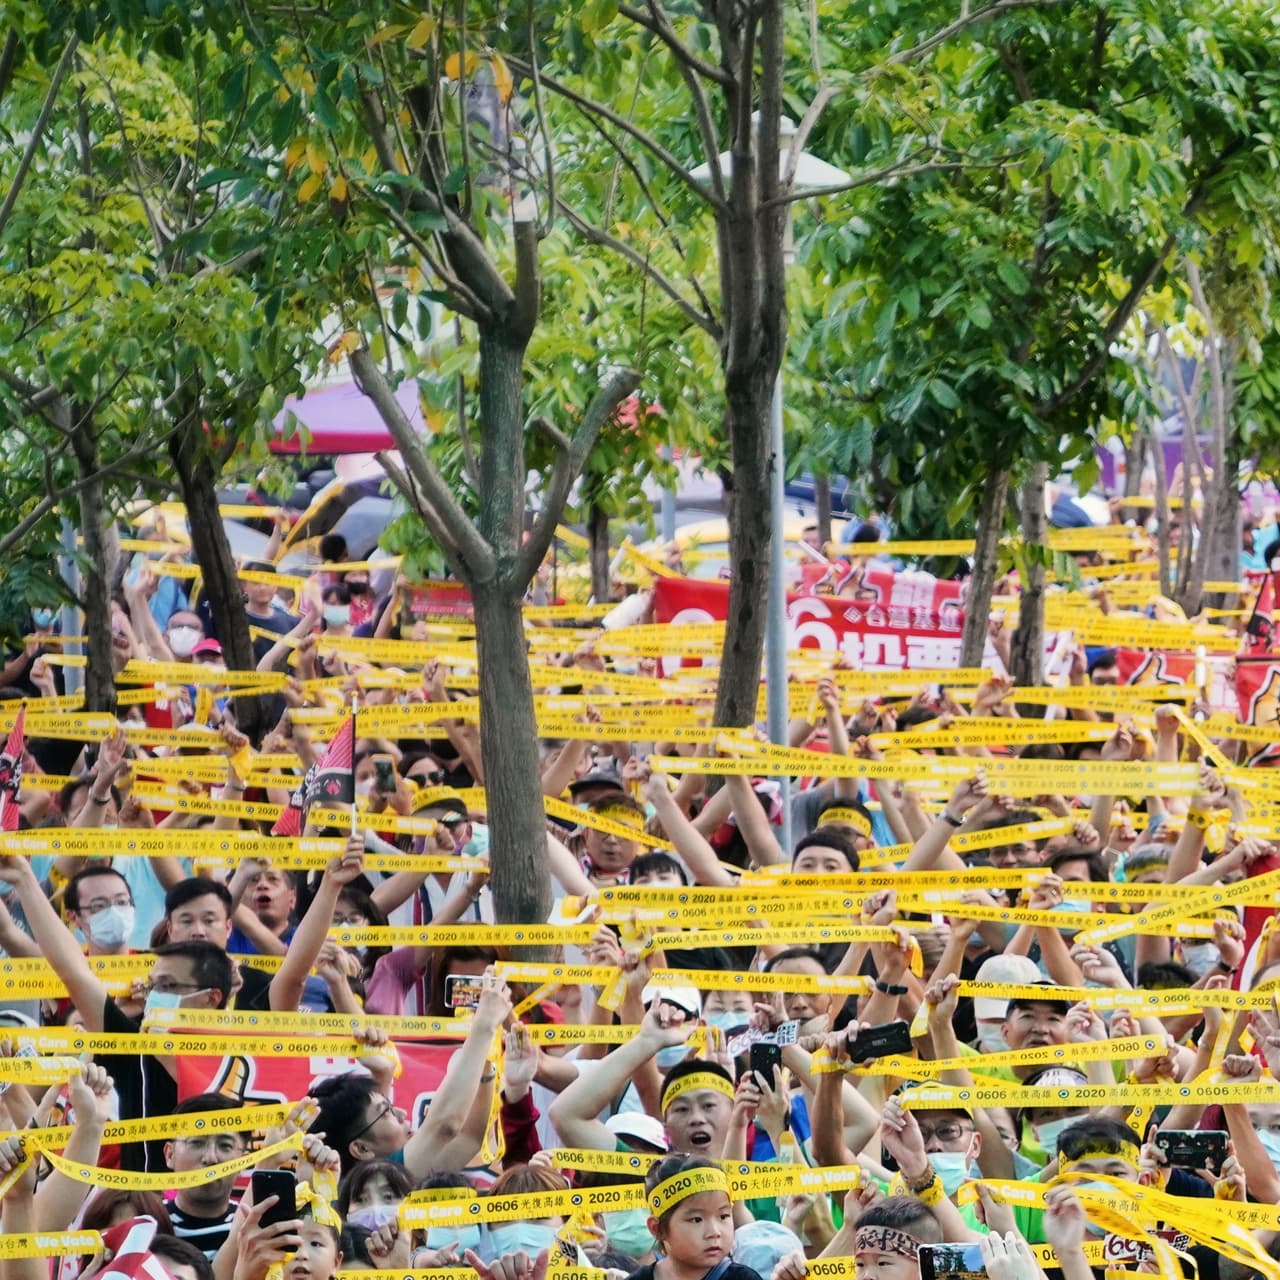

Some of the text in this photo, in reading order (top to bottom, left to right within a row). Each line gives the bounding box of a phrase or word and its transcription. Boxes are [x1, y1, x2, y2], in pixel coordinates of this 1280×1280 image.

[975, 1089, 1008, 1101] 0606
[1075, 1088, 1106, 1099] 2020
[1196, 1086, 1228, 1097] 0606
